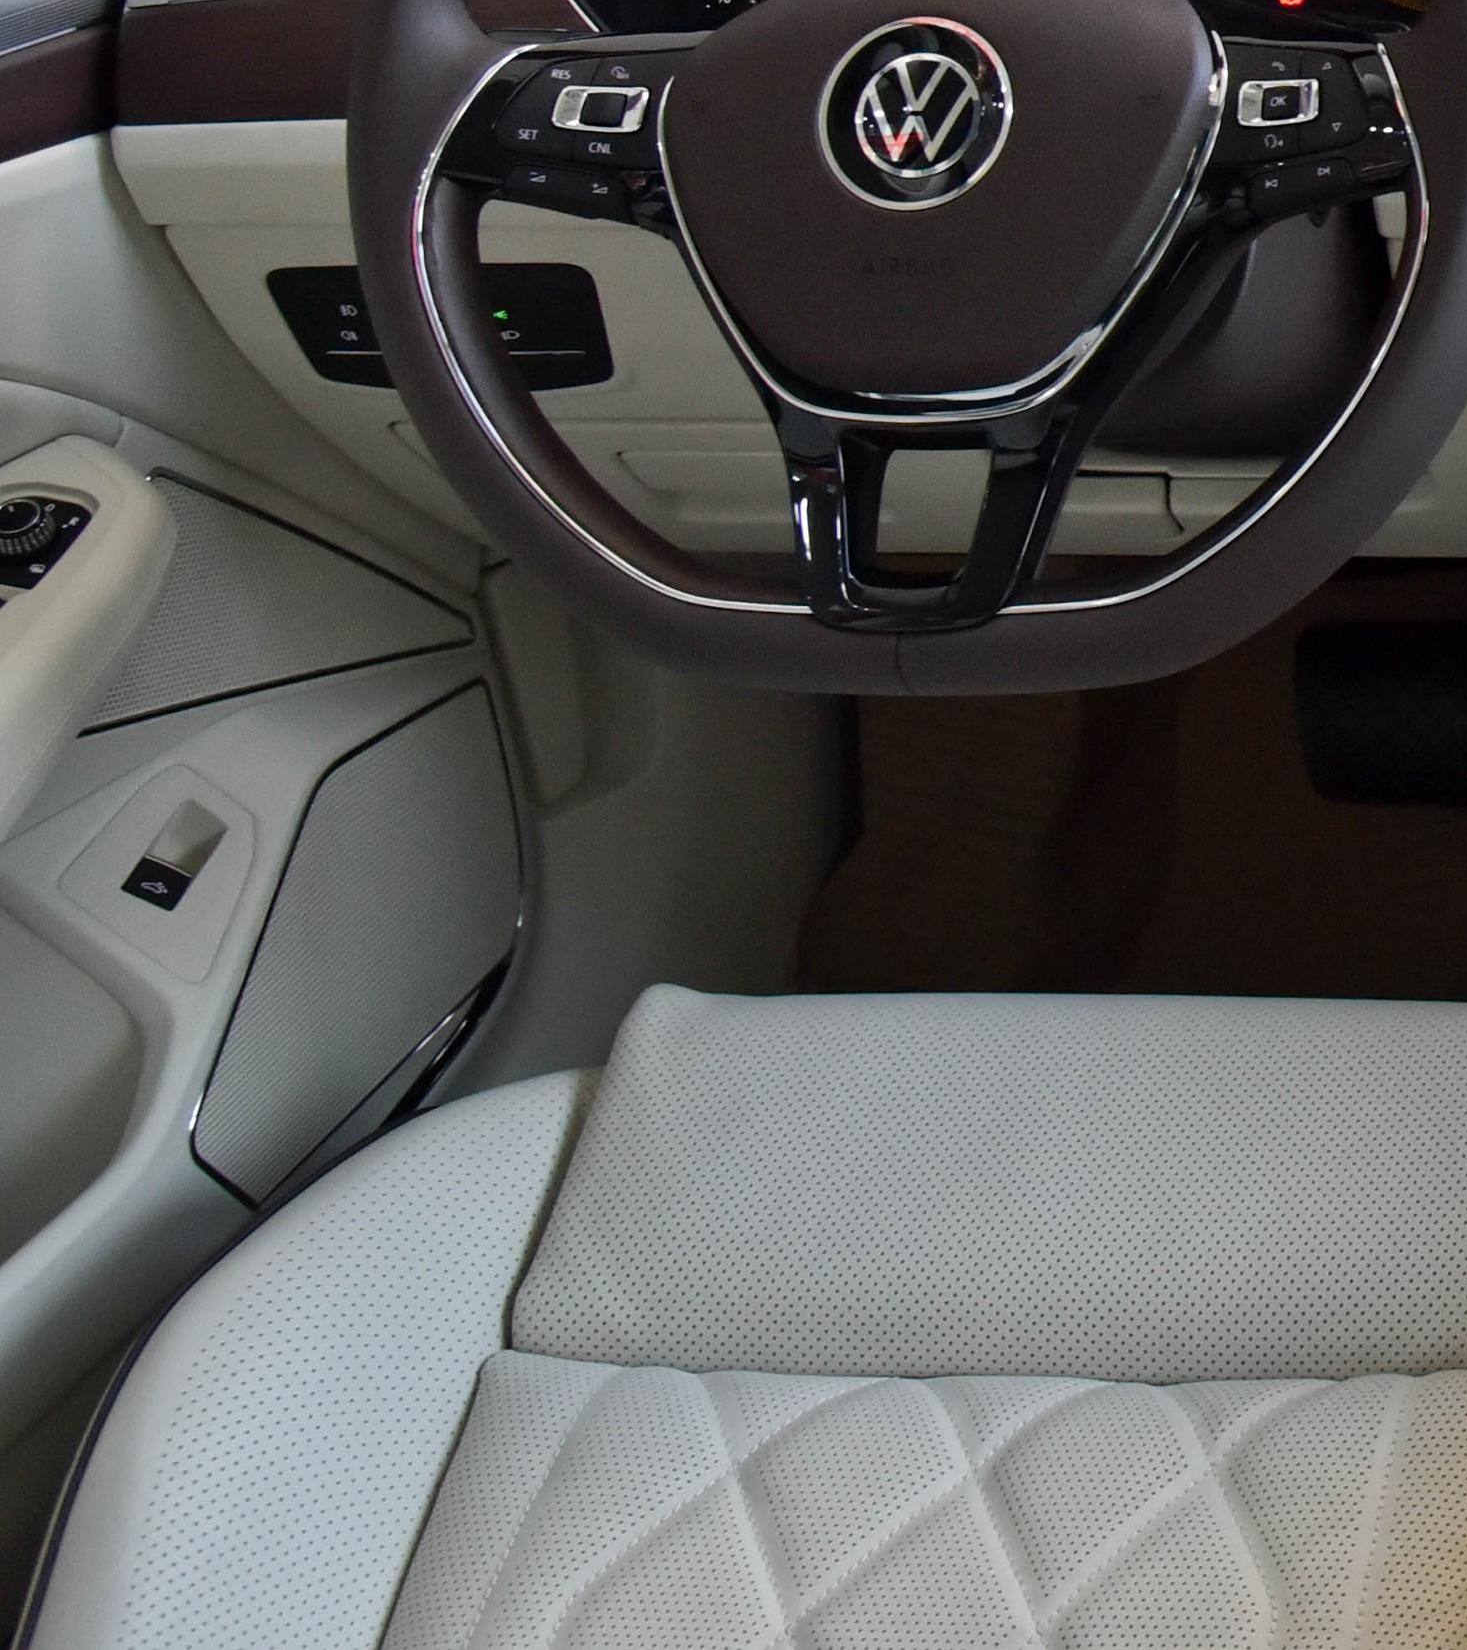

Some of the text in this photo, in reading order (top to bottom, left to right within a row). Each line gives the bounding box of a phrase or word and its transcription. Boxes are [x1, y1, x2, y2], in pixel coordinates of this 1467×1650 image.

[551, 68, 572, 80] RES
[1270, 95, 1288, 107] OK
[518, 129, 539, 141] SET
[588, 142, 612, 155] CNL
